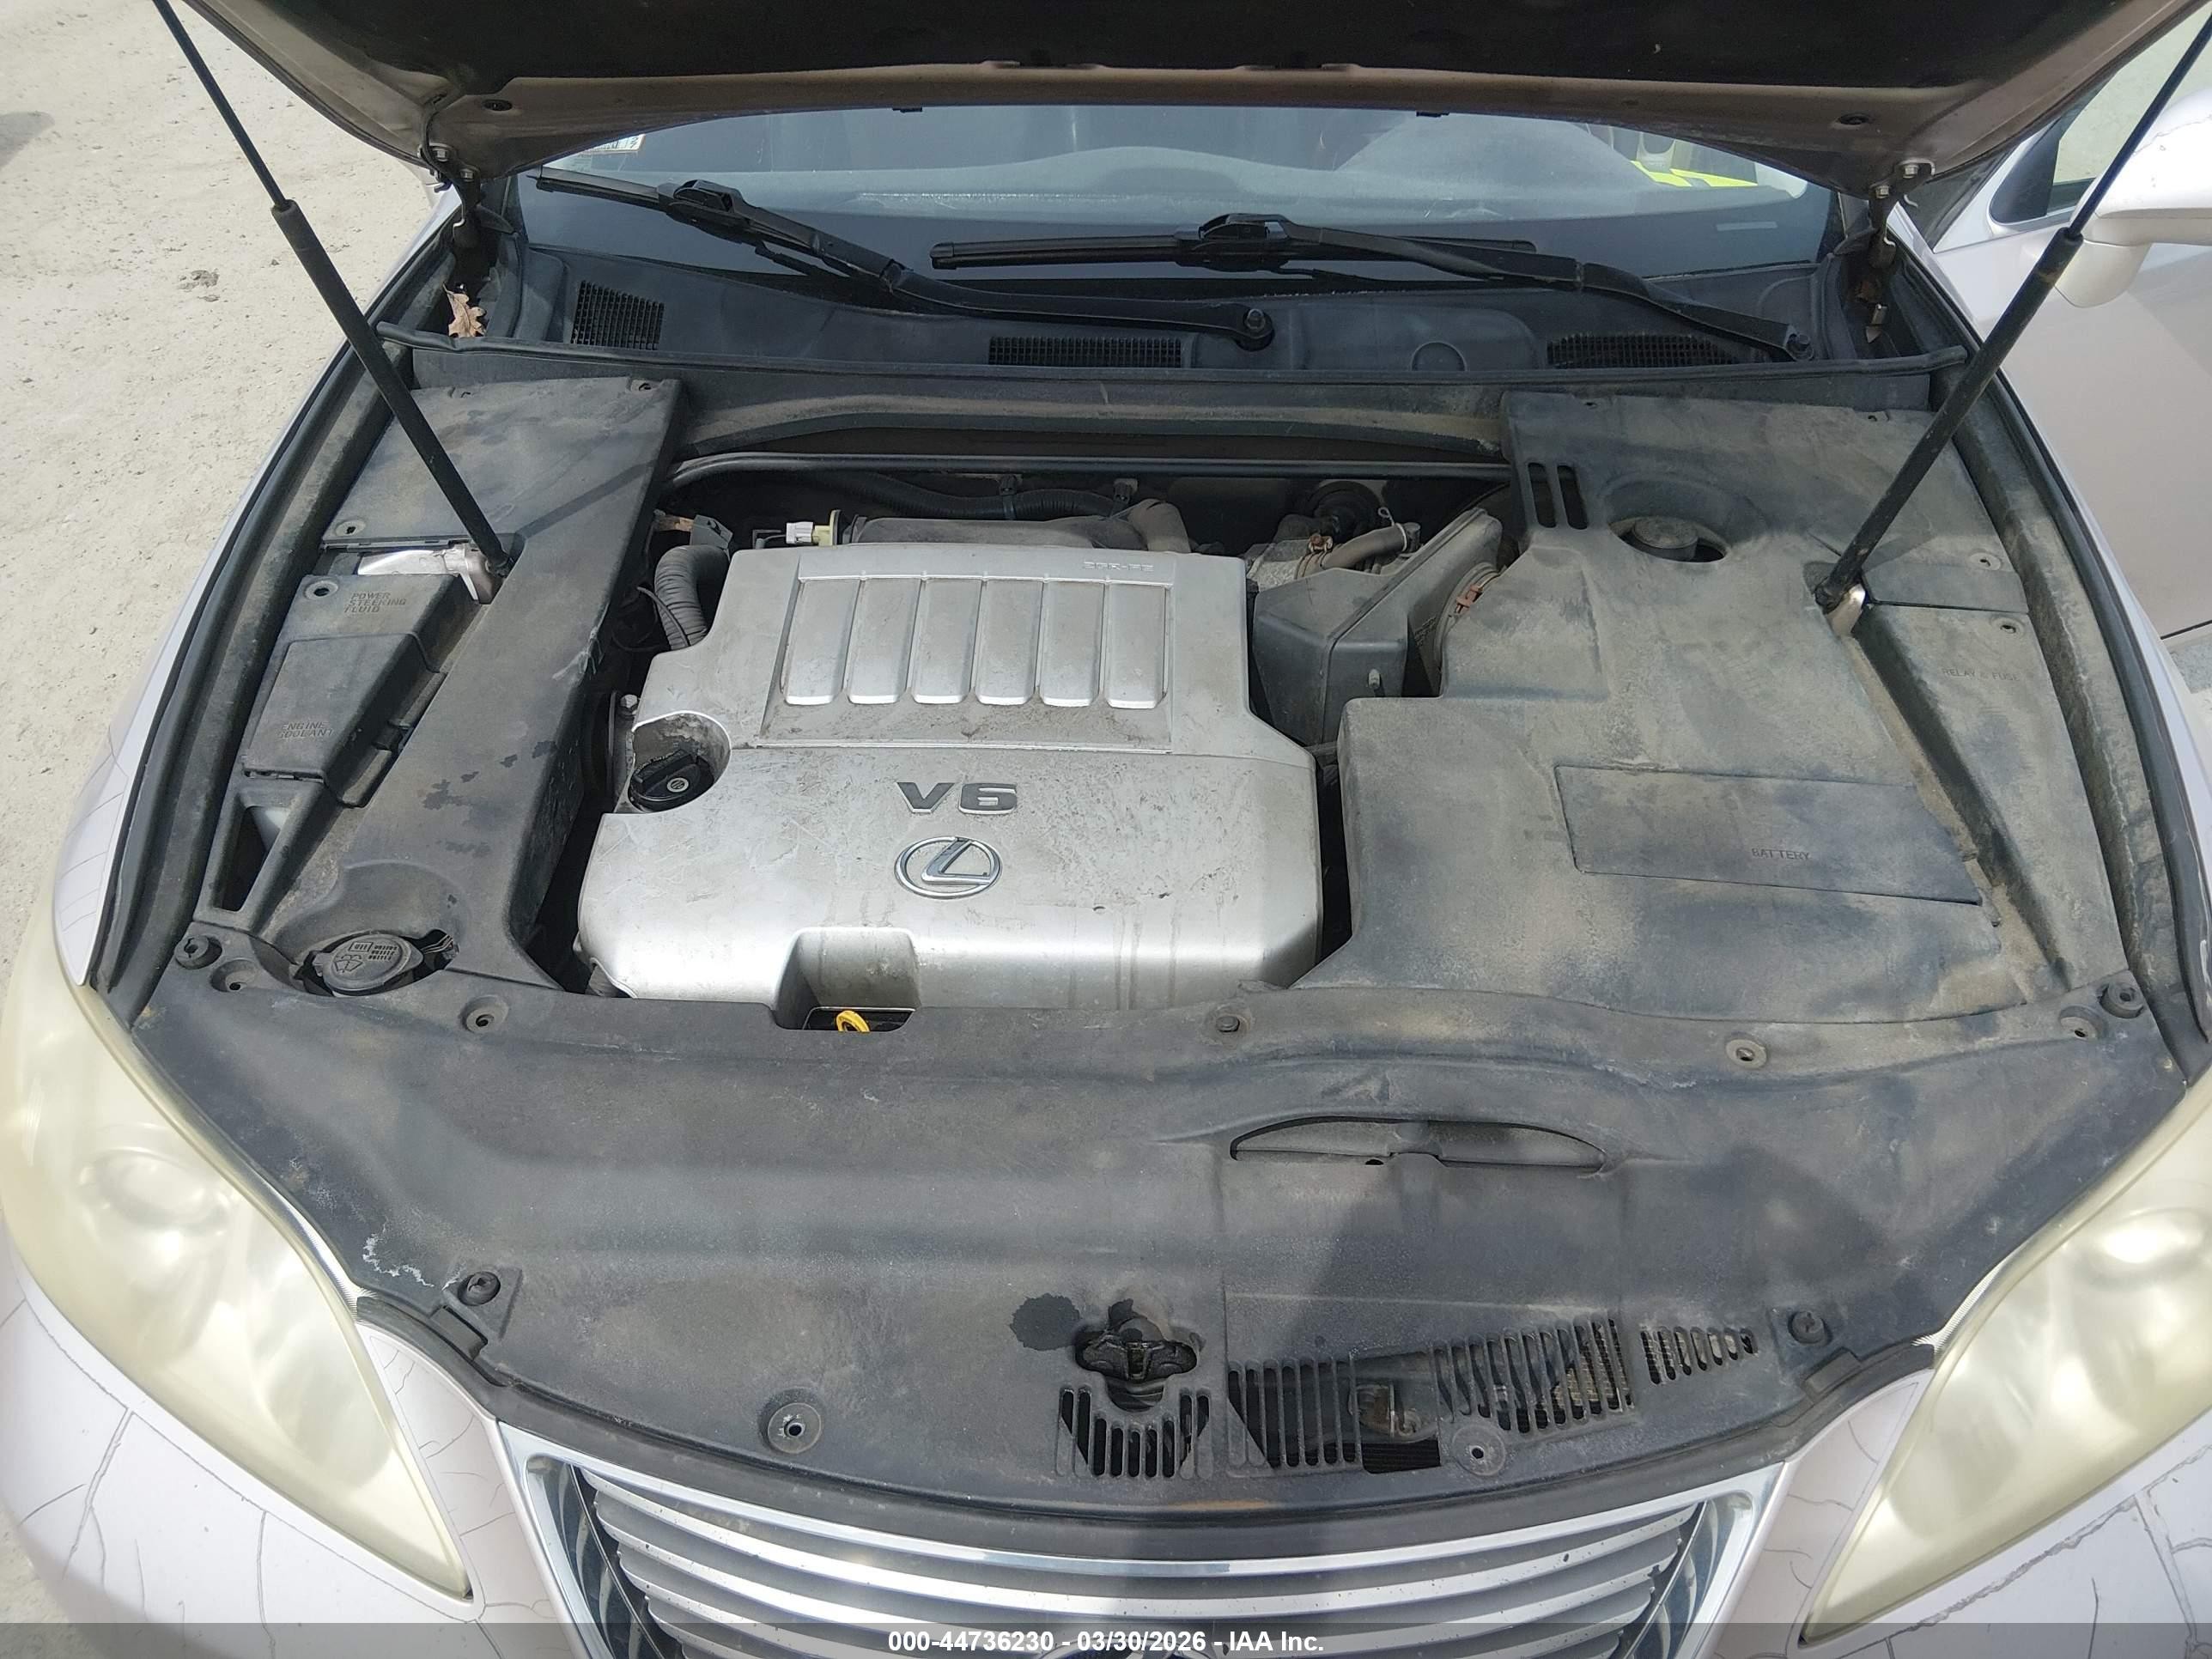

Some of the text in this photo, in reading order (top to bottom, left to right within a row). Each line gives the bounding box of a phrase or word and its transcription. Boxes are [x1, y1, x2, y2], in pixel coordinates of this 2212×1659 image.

[282, 721, 327, 730] ENGINE
[896, 781, 1018, 816] V6
[1752, 848, 1810, 860] BATTERY
